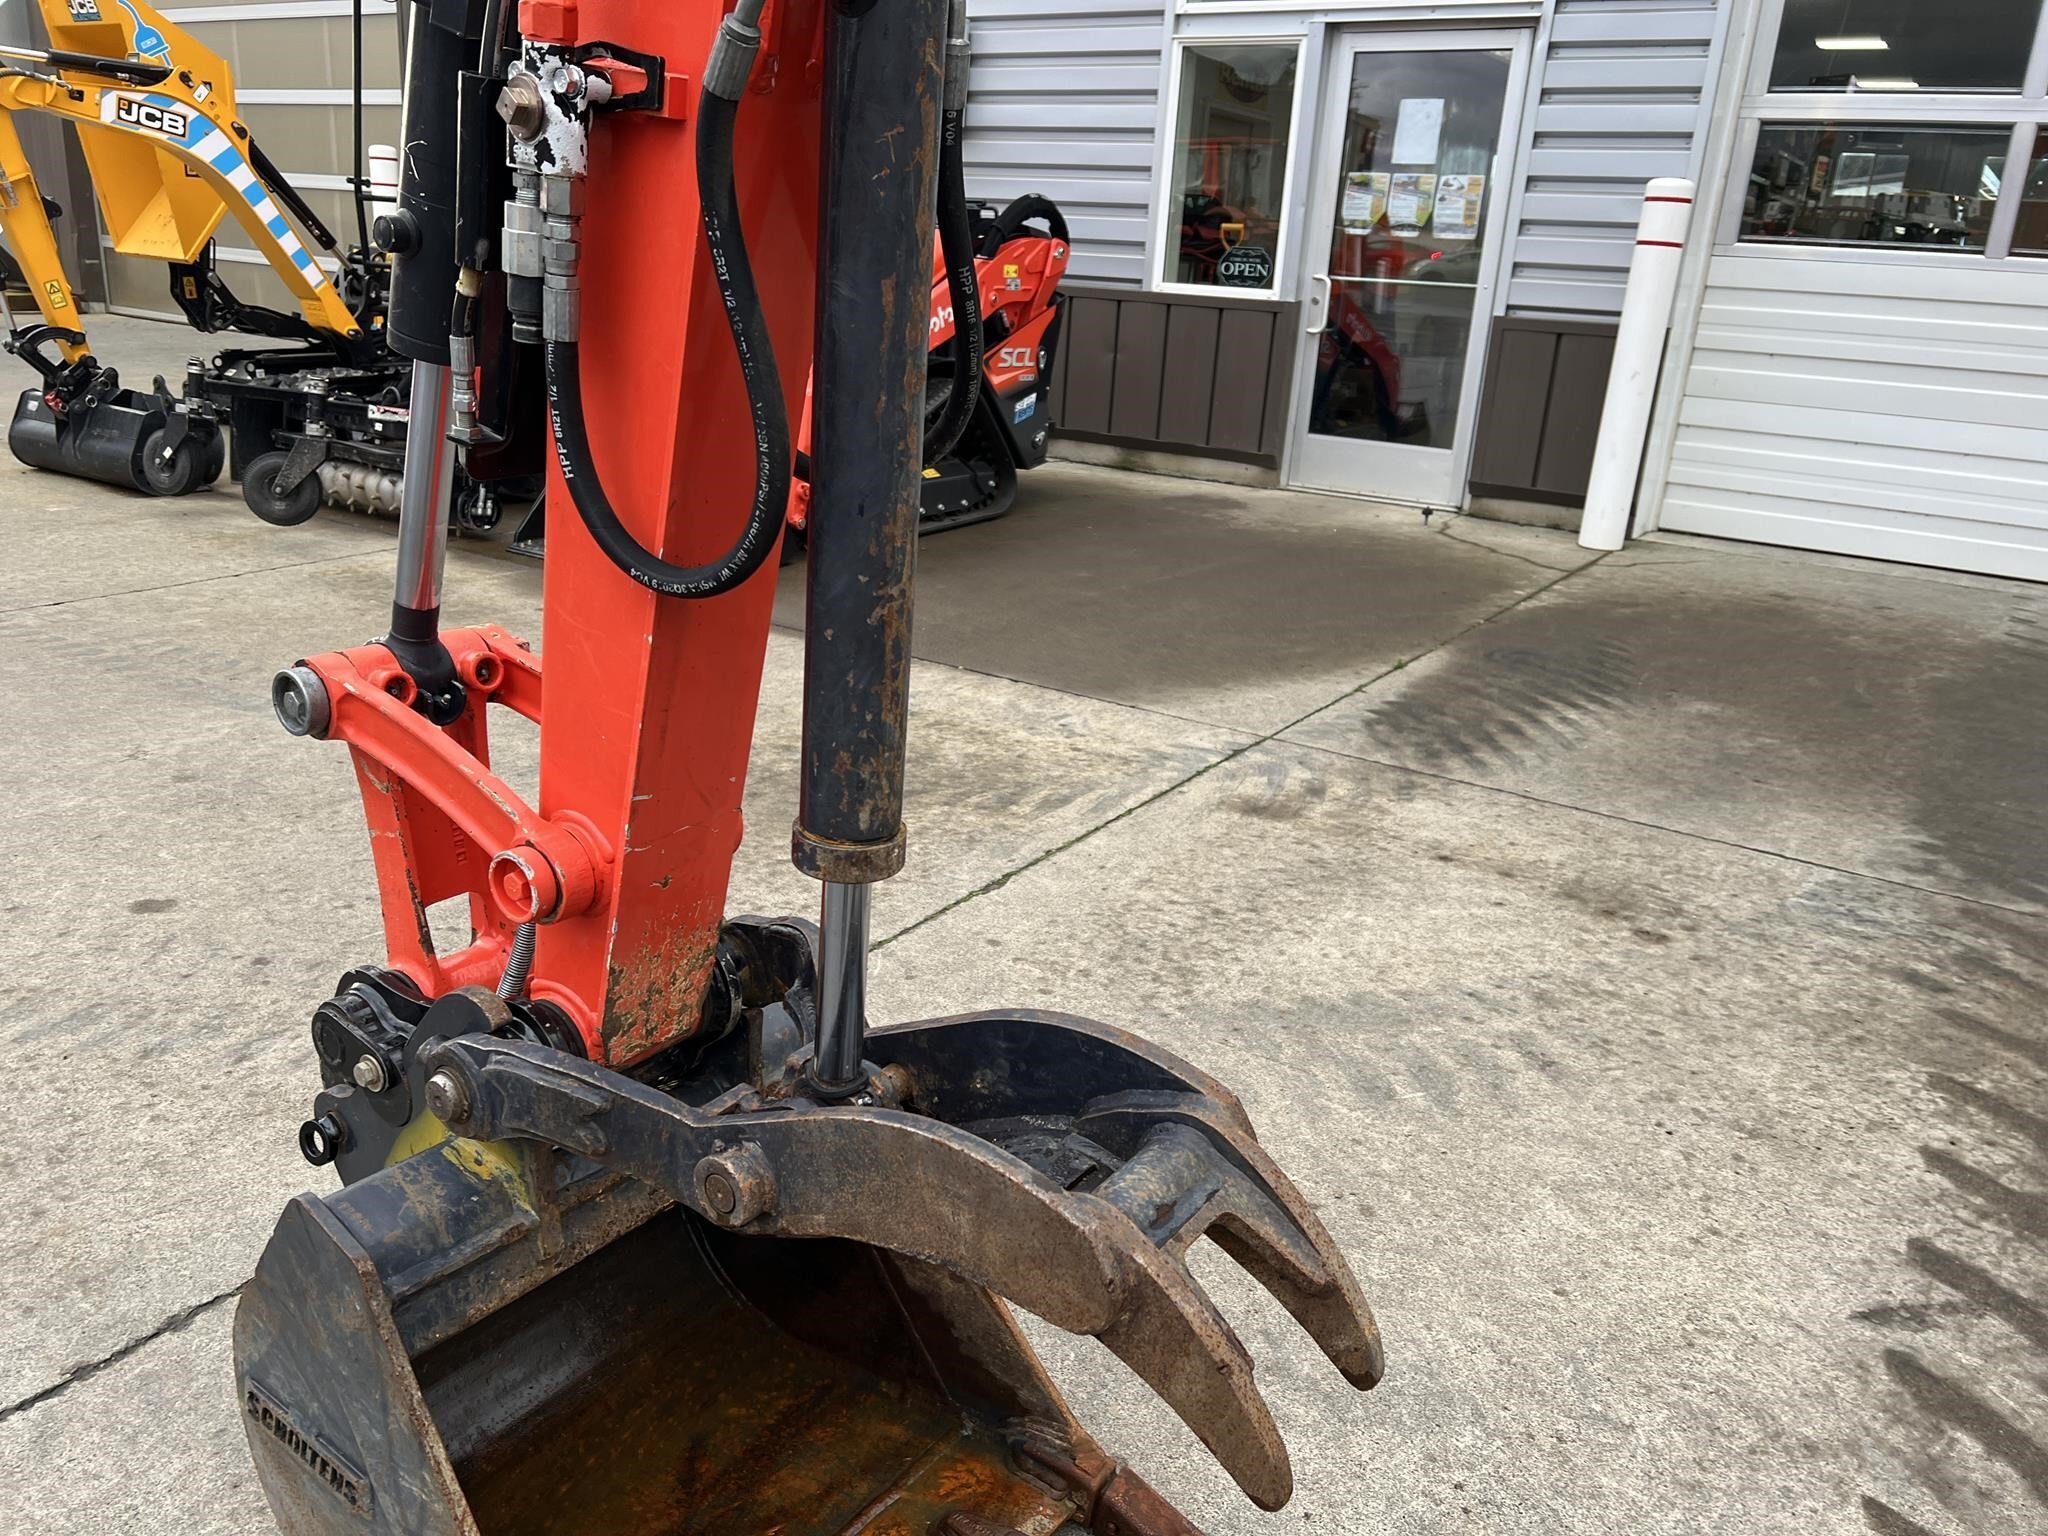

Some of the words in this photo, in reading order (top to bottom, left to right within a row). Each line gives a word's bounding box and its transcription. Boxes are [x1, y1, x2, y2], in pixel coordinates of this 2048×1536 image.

[68, 0, 98, 14] JCB
[119, 100, 185, 135] JCB
[957, 265, 974, 295] HPP
[1221, 261, 1269, 276] OPEN
[998, 347, 1035, 368] SCL
[551, 408, 563, 438] 8R2T
[557, 442, 575, 480] HPP
[247, 1391, 358, 1506] SCHOLTENS
